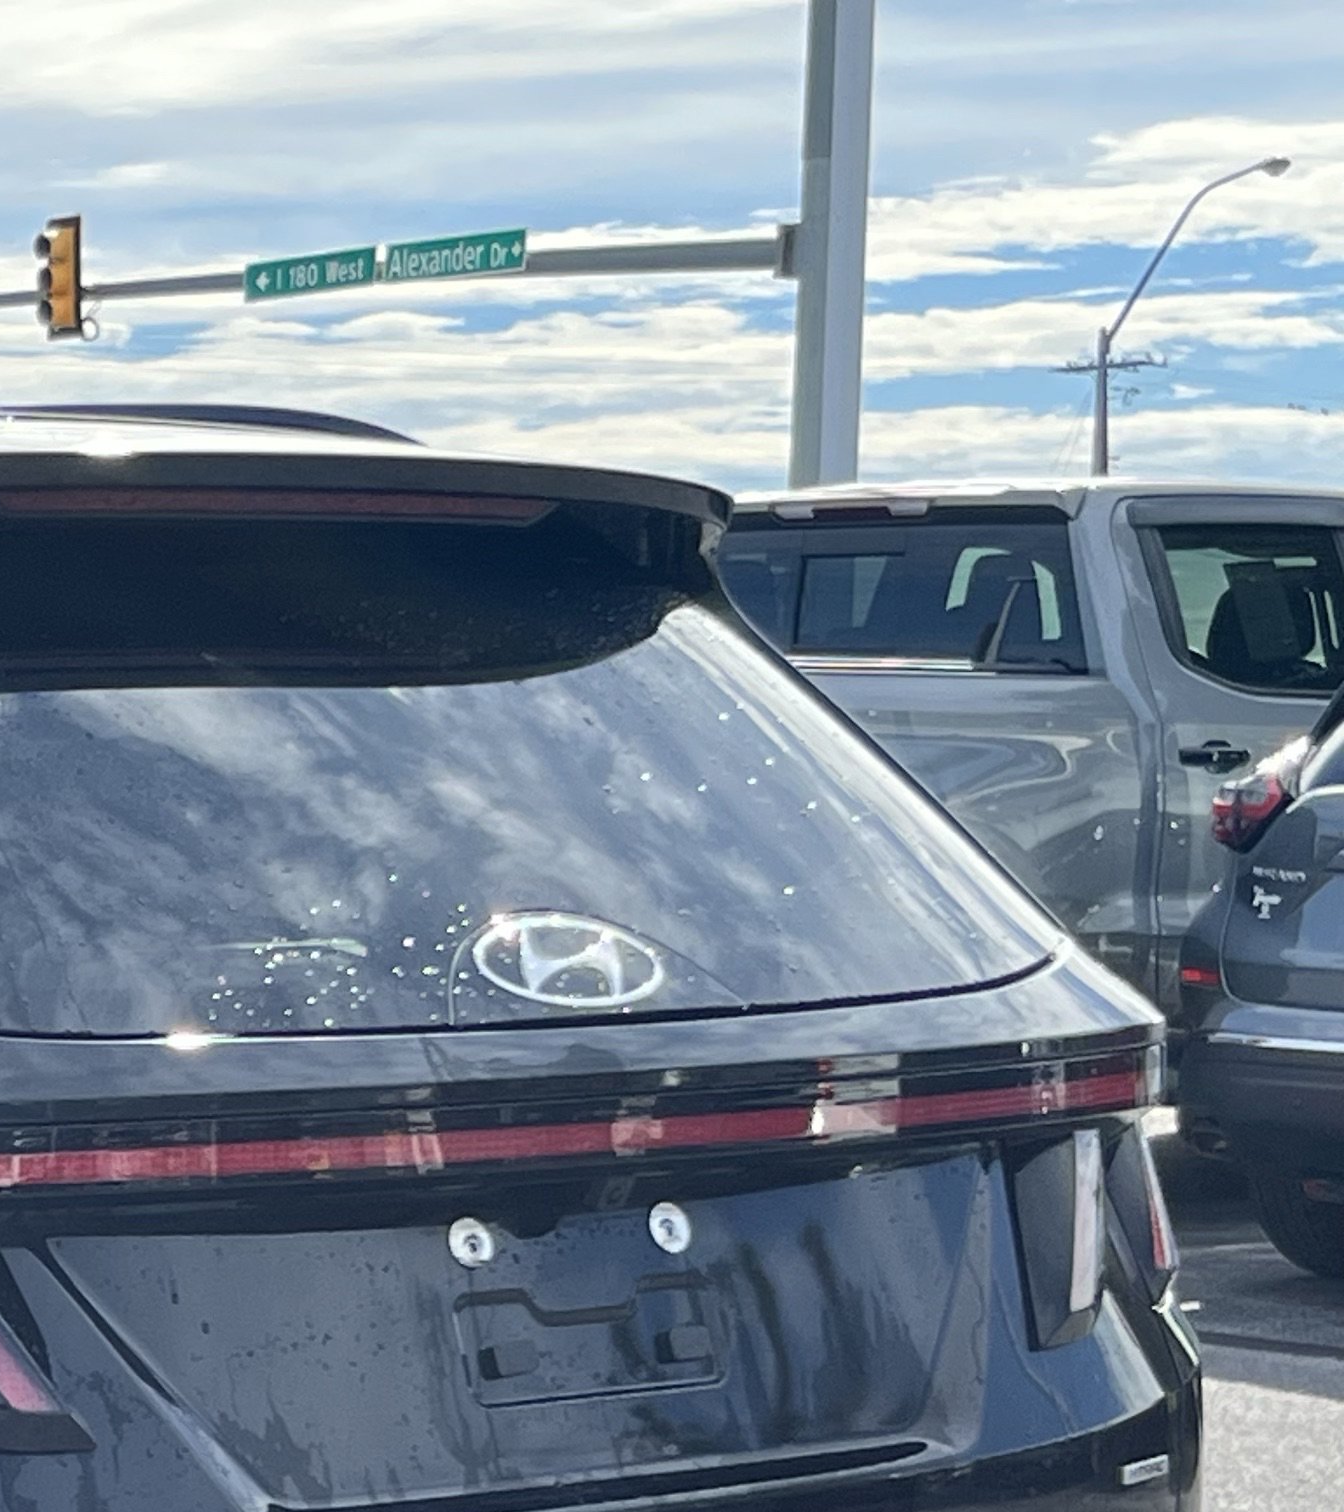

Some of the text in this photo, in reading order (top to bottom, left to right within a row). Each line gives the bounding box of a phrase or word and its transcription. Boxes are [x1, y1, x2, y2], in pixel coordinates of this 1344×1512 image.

[275, 257, 364, 290] I 180 West
[388, 240, 509, 279] Alexander Dr
